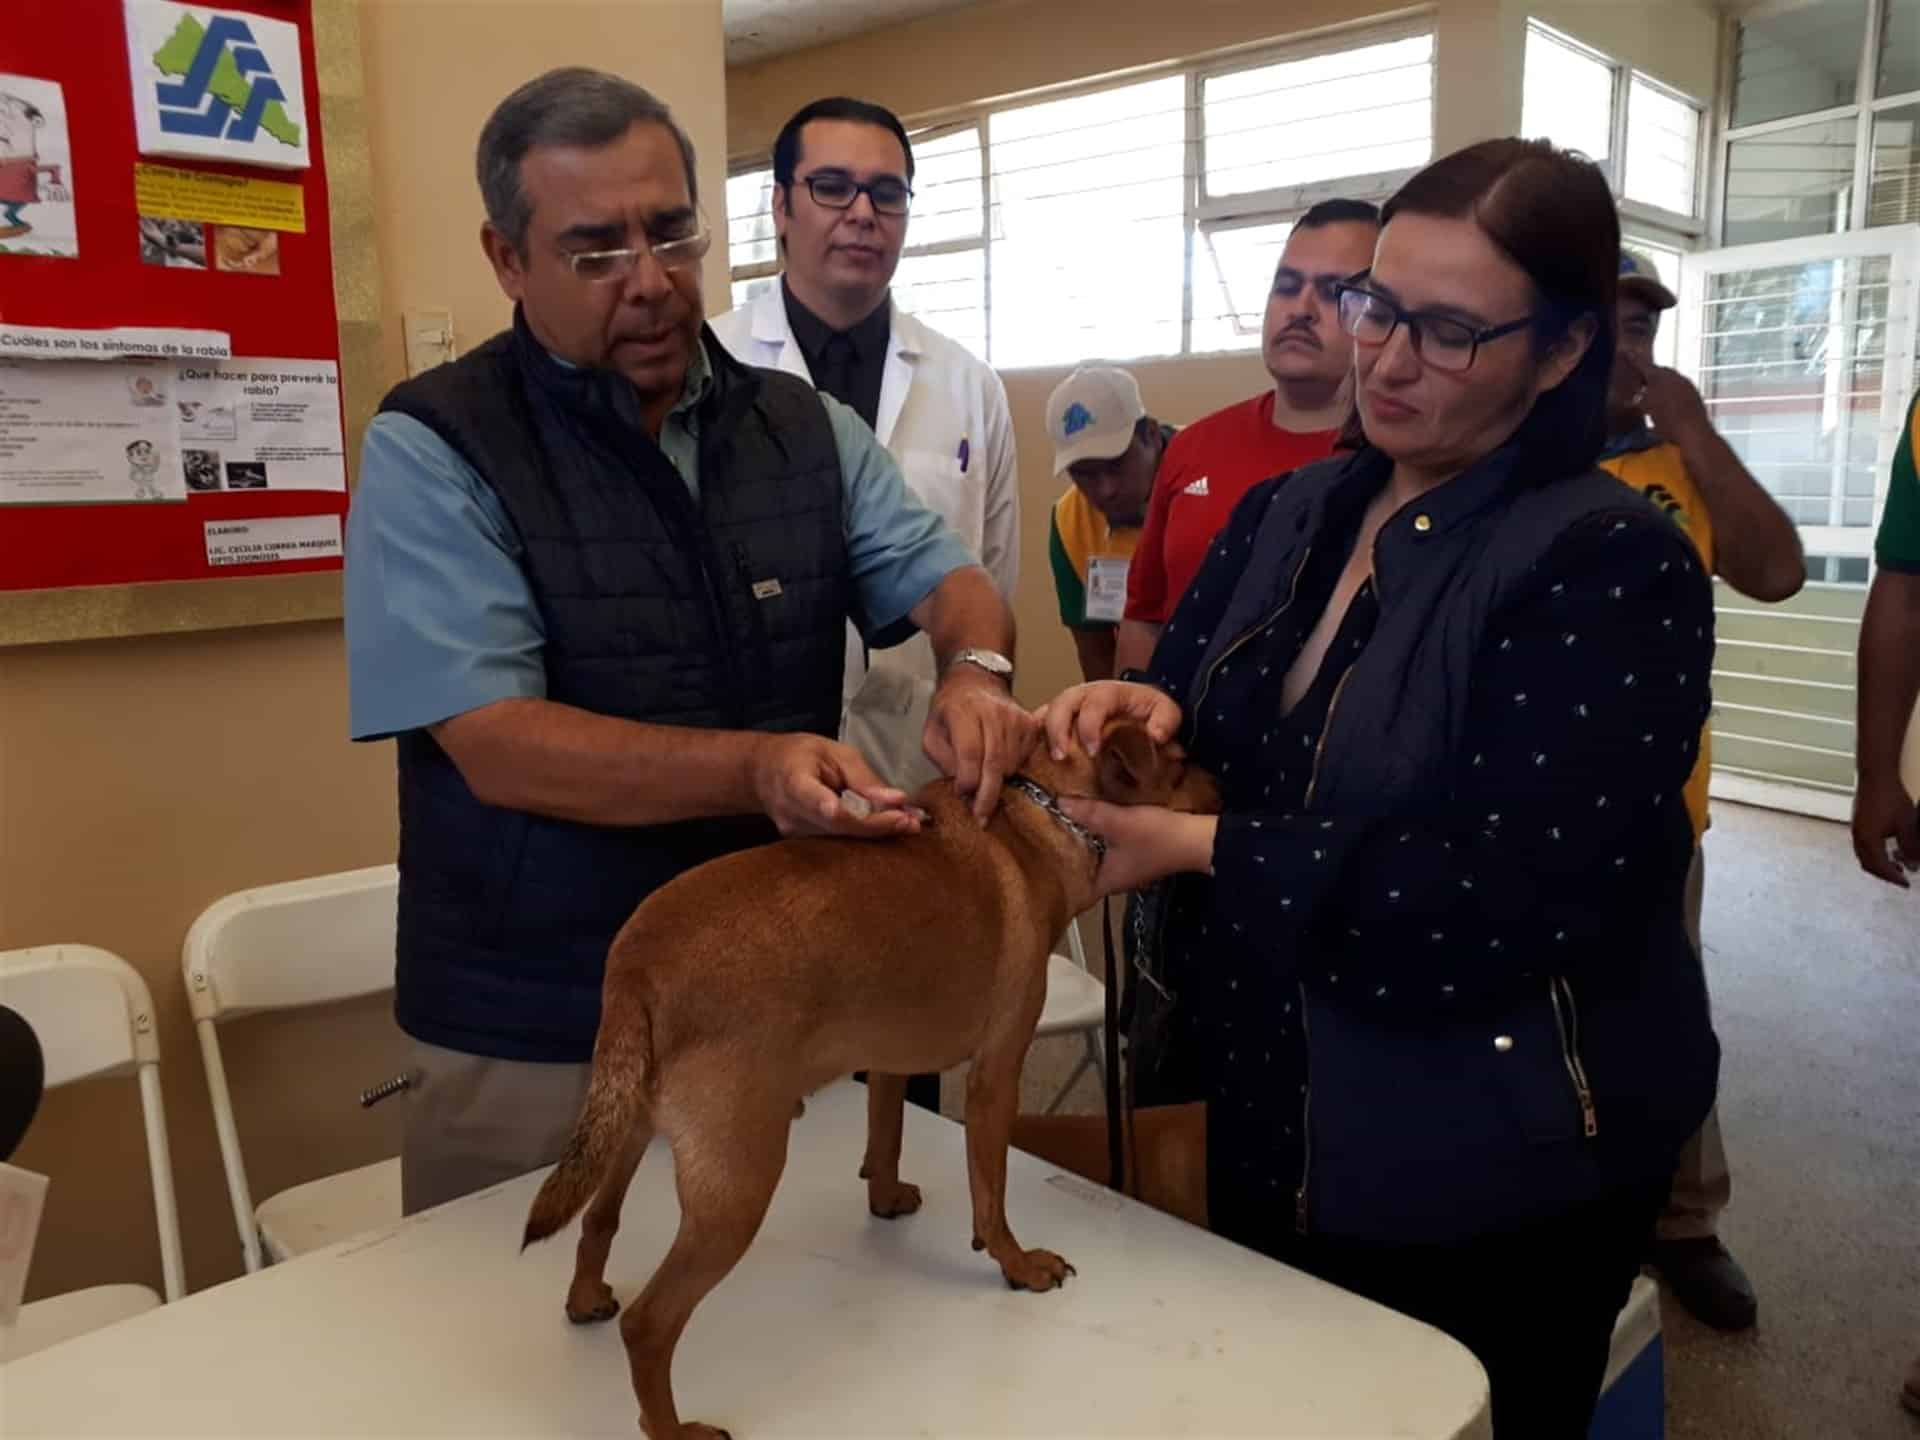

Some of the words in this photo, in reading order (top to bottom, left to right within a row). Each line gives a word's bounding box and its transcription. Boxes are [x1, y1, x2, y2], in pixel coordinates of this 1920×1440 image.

[53, 338, 77, 349] son
[80, 338, 99, 350] los
[161, 343, 178, 354] de
[181, 344, 193, 354] la
[196, 345, 228, 356] rabia
[214, 368, 247, 381] hacer
[251, 372, 277, 383] para
[326, 373, 338, 384] la
[243, 384, 280, 396] rabia?
